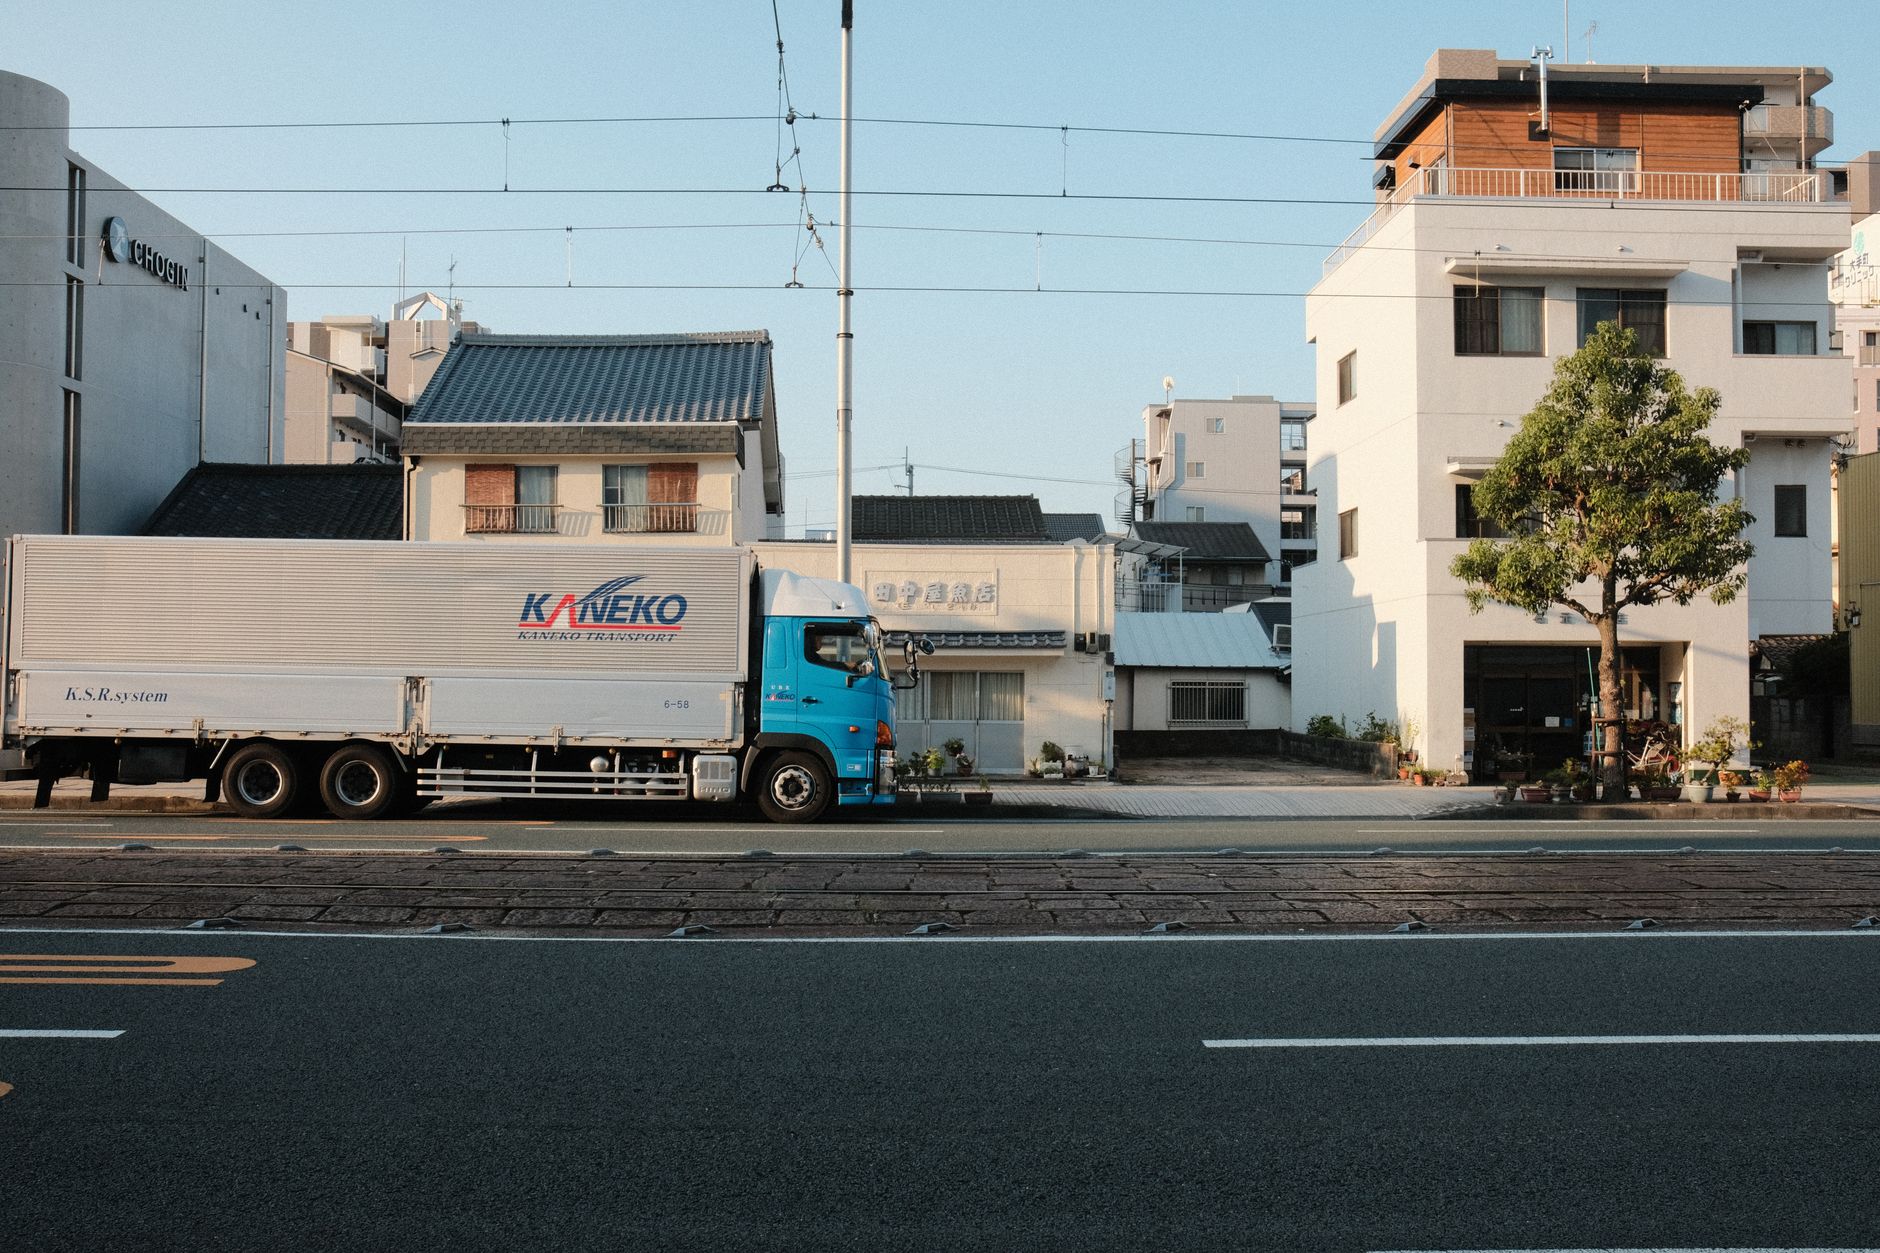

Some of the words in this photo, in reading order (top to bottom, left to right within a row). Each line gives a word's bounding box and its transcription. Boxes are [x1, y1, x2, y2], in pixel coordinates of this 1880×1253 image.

[133, 239, 189, 291] CHOGIN
[1845, 265, 1875, 288] クリニック
[519, 592, 688, 628] KANEKO
[518, 631, 581, 640] KANEKO
[586, 632, 677, 642] TRANSPORT
[65, 687, 169, 704] K.S.R.system
[664, 700, 690, 709] 6-58
